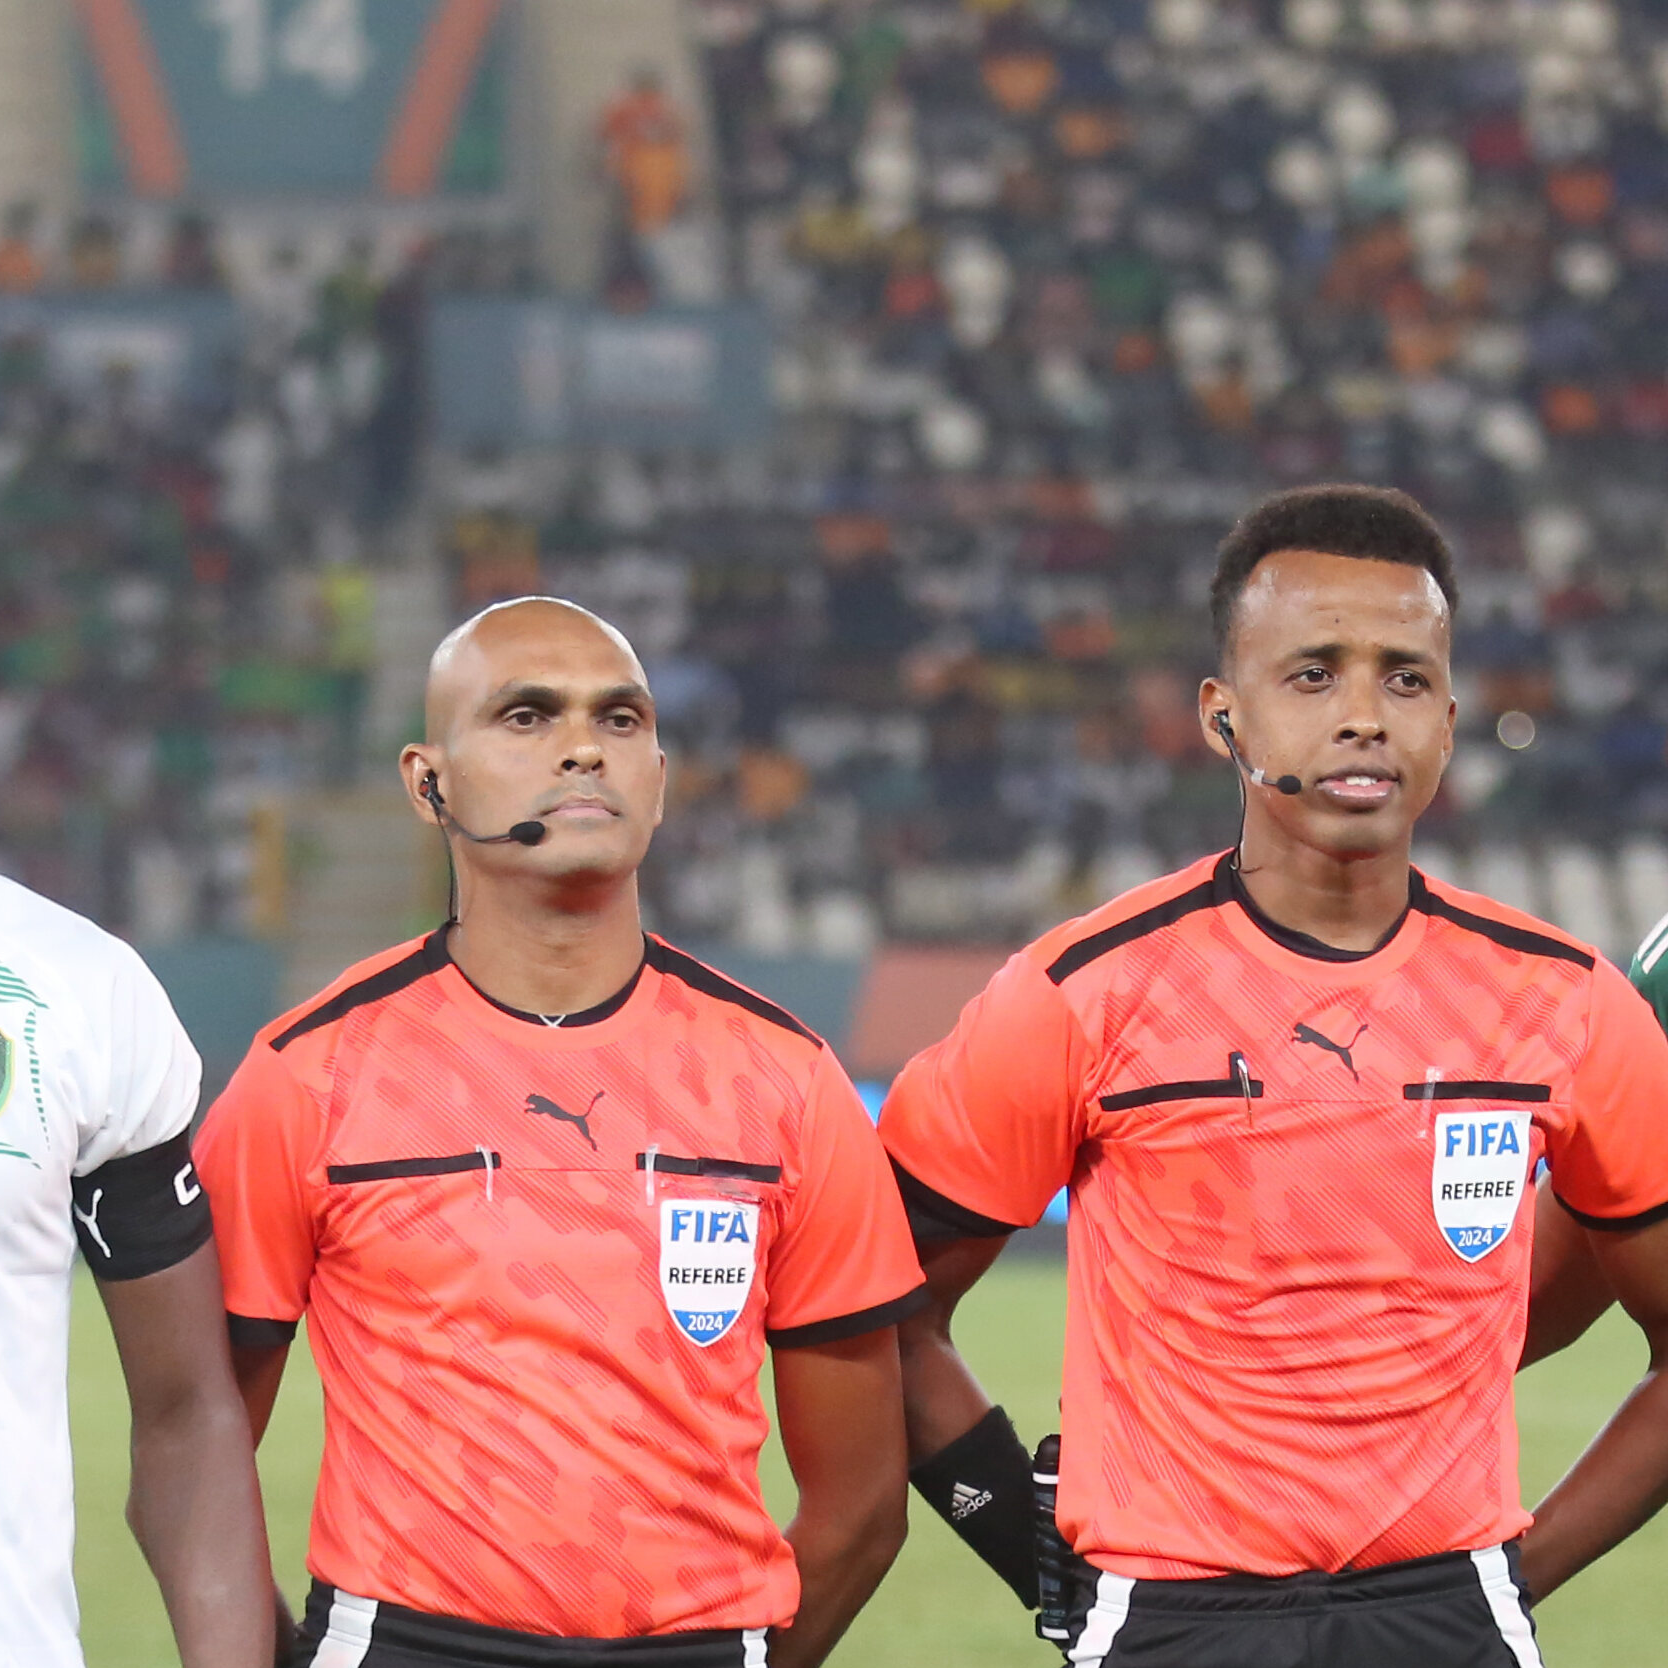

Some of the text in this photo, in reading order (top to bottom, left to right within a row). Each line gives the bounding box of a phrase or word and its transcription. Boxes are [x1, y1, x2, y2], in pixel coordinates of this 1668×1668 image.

[200, 0, 372, 93] 14
[1445, 1120, 1520, 1157] FIFA
[173, 1162, 201, 1206] C
[1441, 1180, 1516, 1200] REFEREE
[670, 1209, 750, 1243] FIFA
[1457, 1229, 1493, 1247] 2024
[668, 1267, 746, 1284] REFEREE
[687, 1314, 724, 1331] 2024
